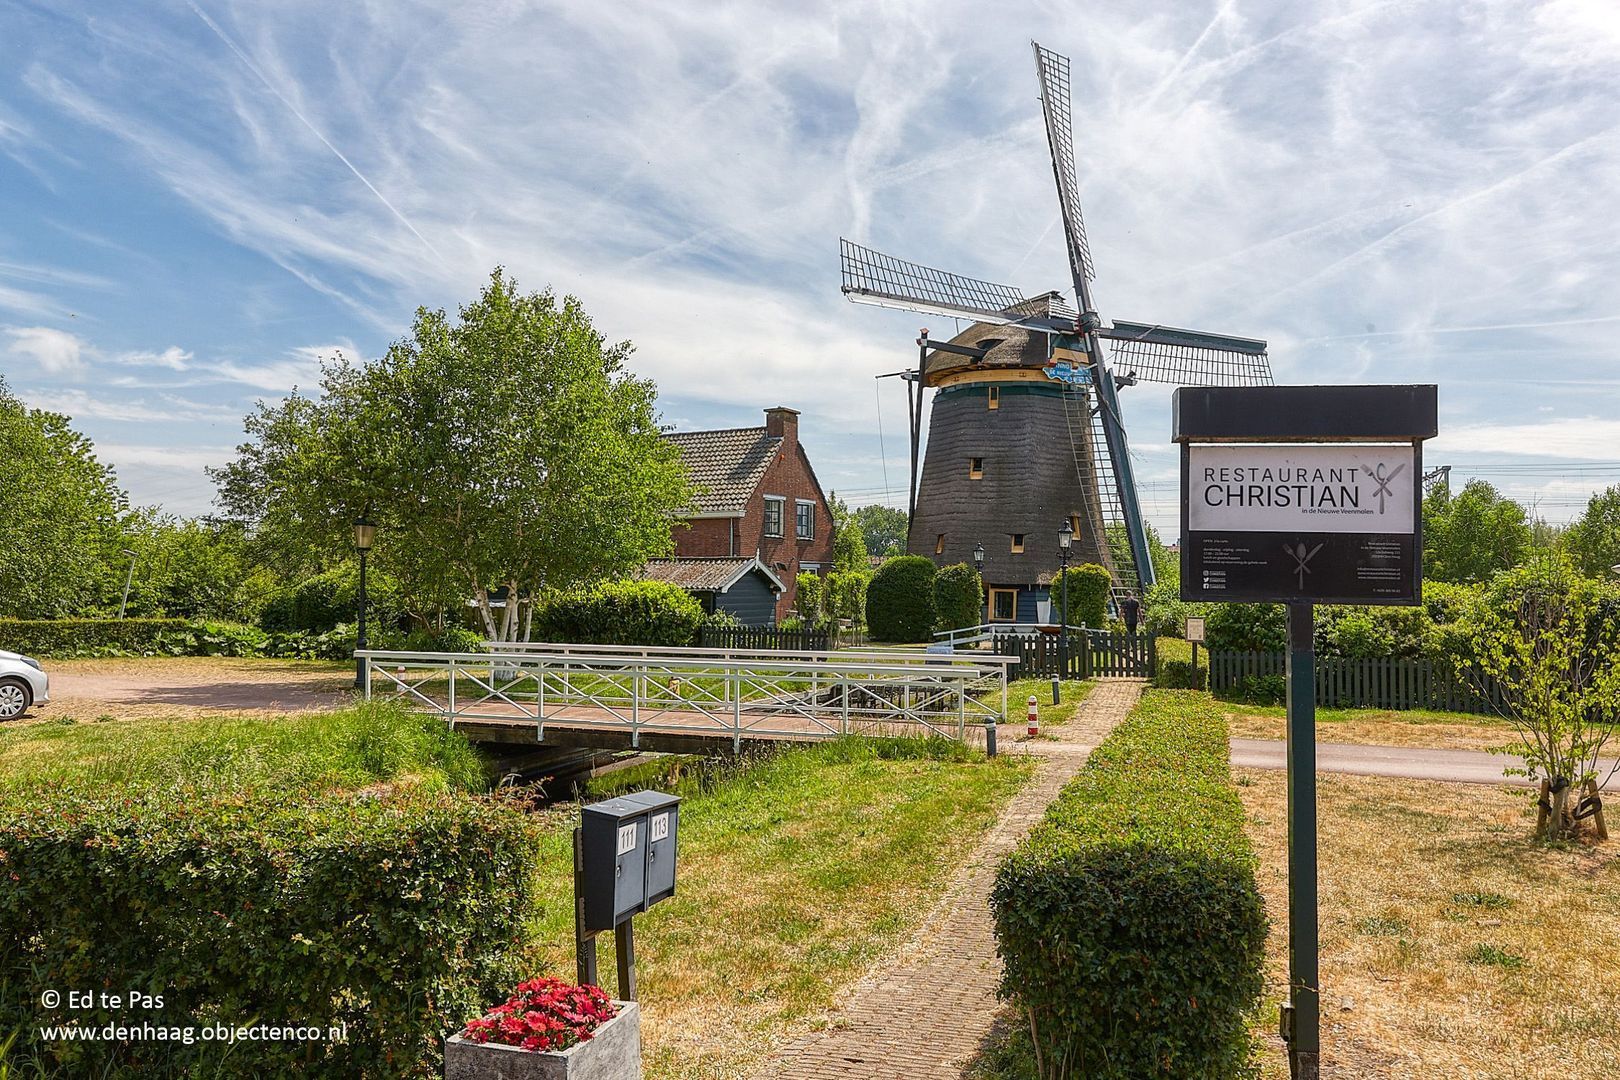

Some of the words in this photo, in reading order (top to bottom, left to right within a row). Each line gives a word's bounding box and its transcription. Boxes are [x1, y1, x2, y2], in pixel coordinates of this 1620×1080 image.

[1204, 467, 1359, 482] RESTAURANT
[1204, 484, 1359, 508] CHRISTIAN
[654, 817, 666, 837] 113
[621, 829, 634, 849] 111
